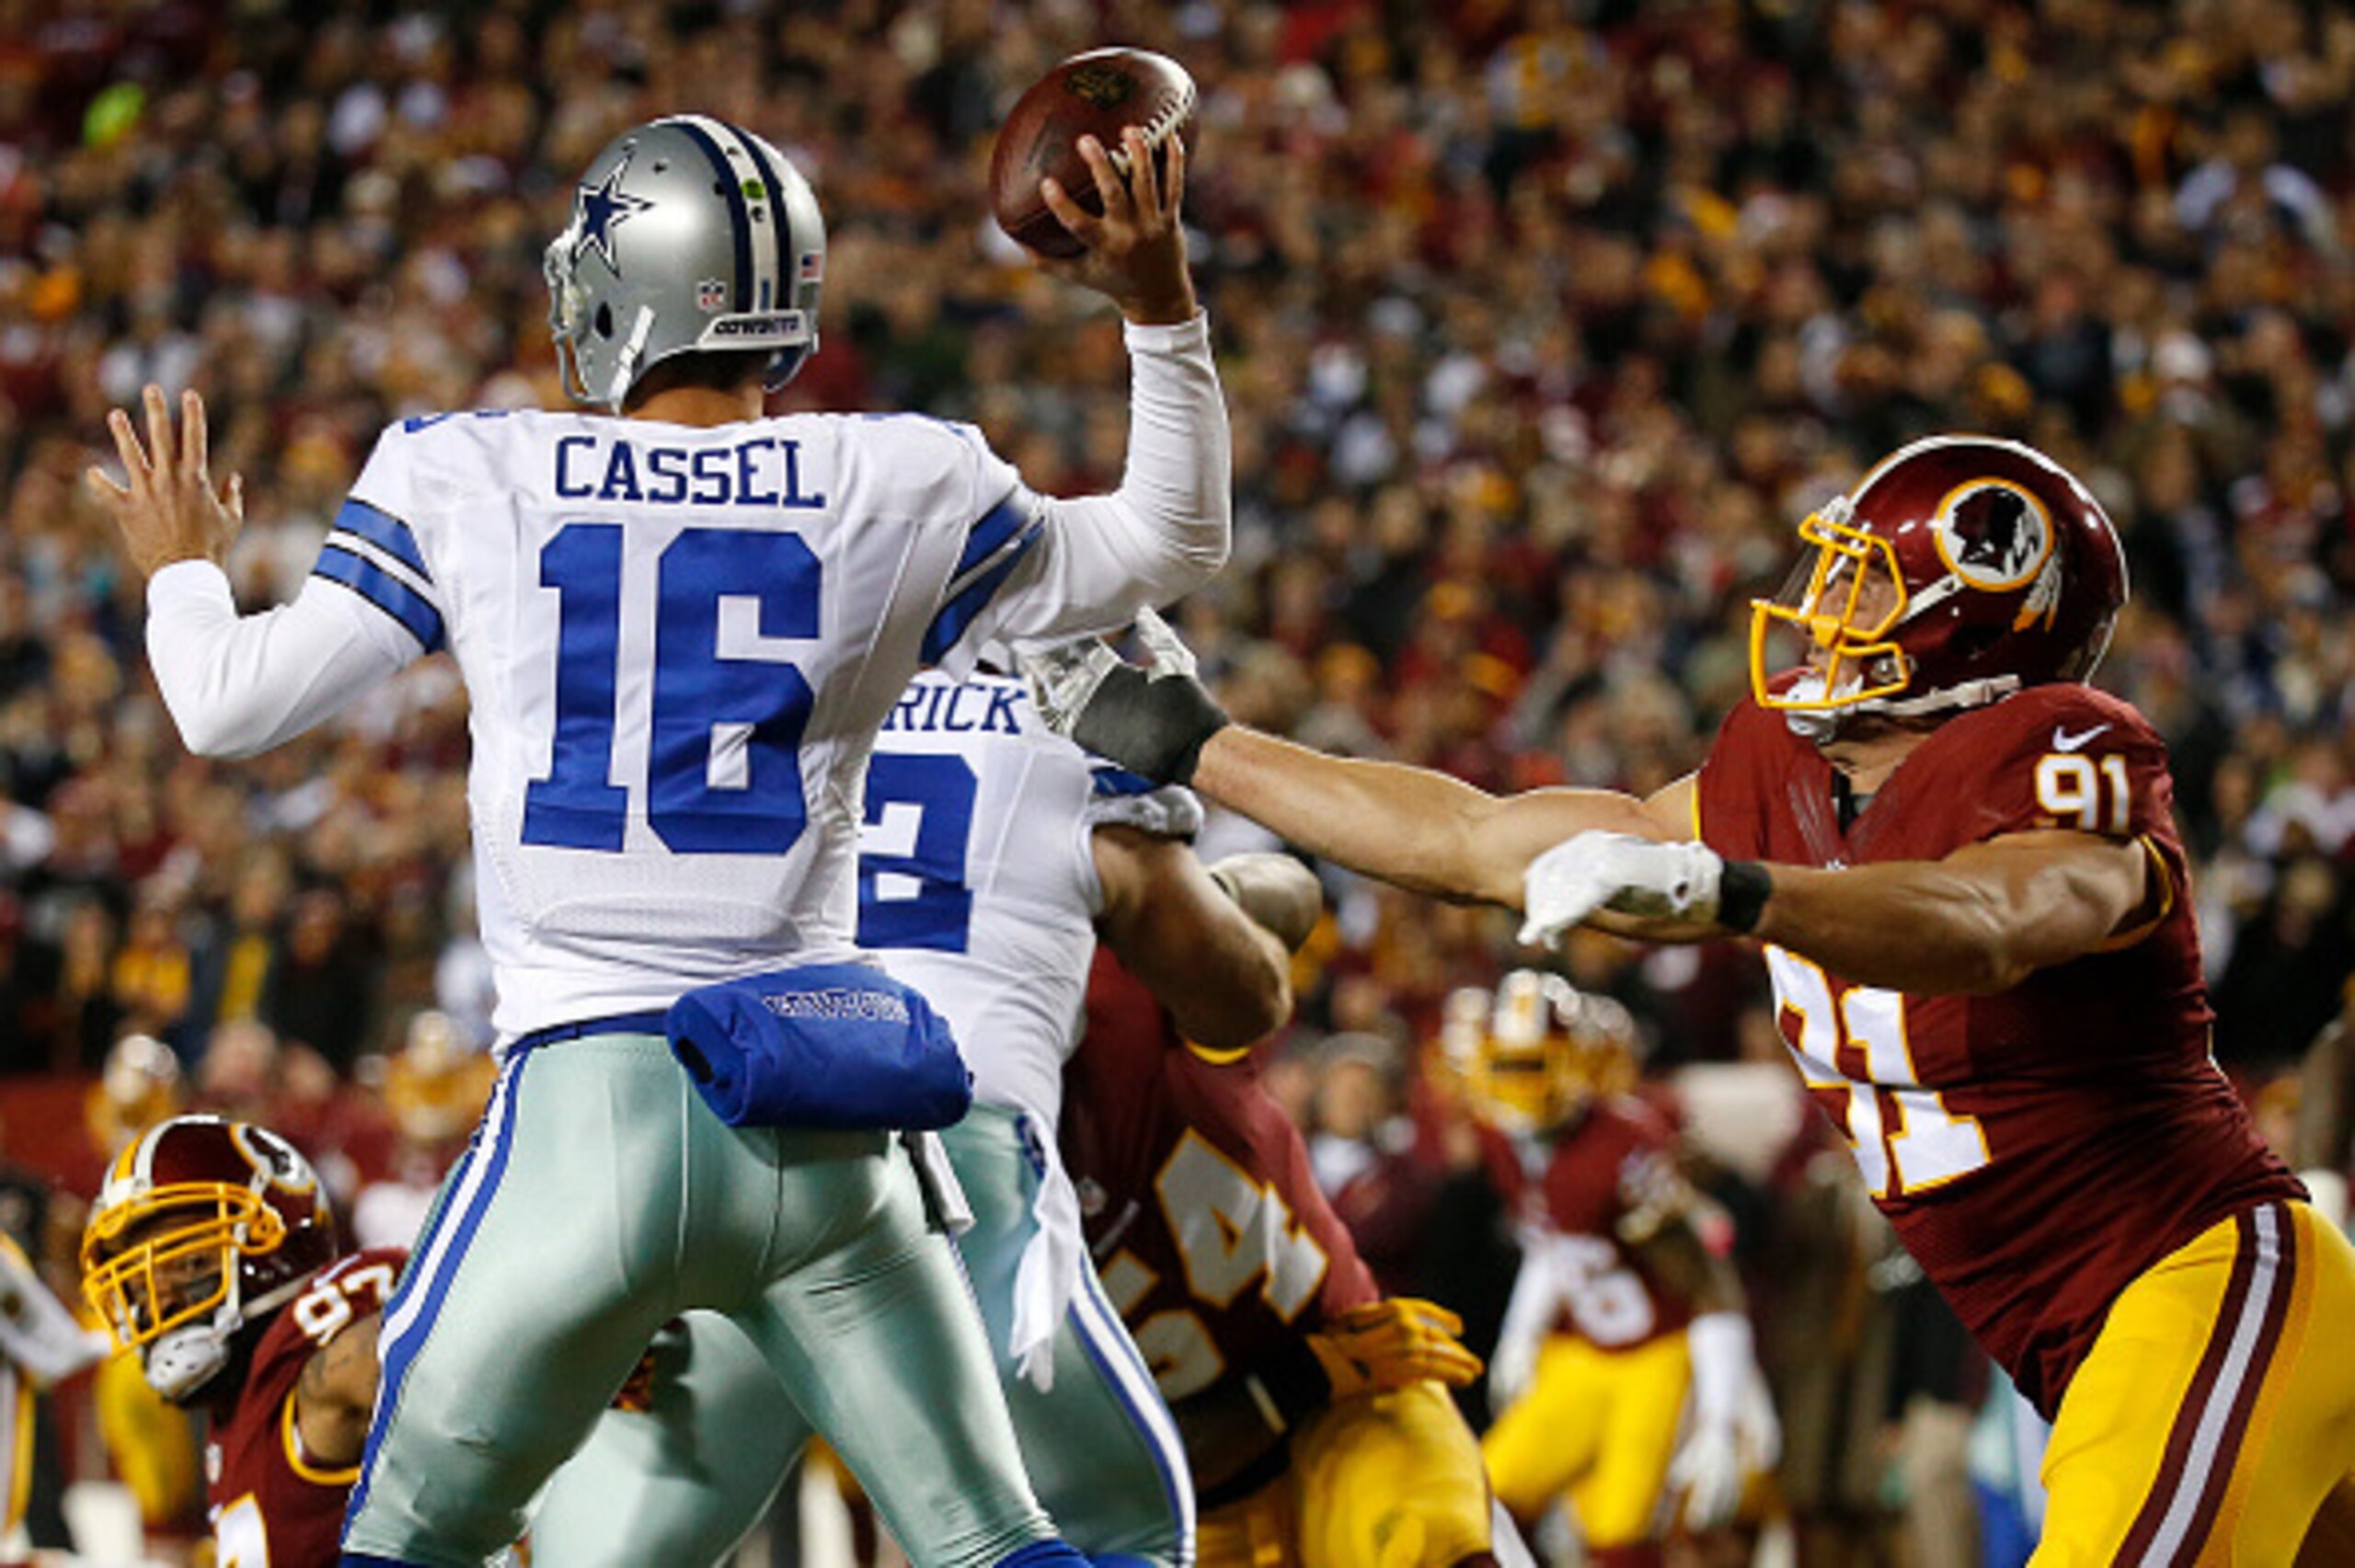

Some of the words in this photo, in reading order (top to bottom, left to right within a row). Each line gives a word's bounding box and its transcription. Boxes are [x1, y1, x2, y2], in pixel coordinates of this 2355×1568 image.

[555, 436, 826, 508] CASSEL
[521, 523, 822, 853] 16
[880, 681, 1028, 735] RICK
[2033, 752, 2130, 832] 91
[1763, 943, 1993, 1199] 91
[292, 1263, 396, 1346] 97
